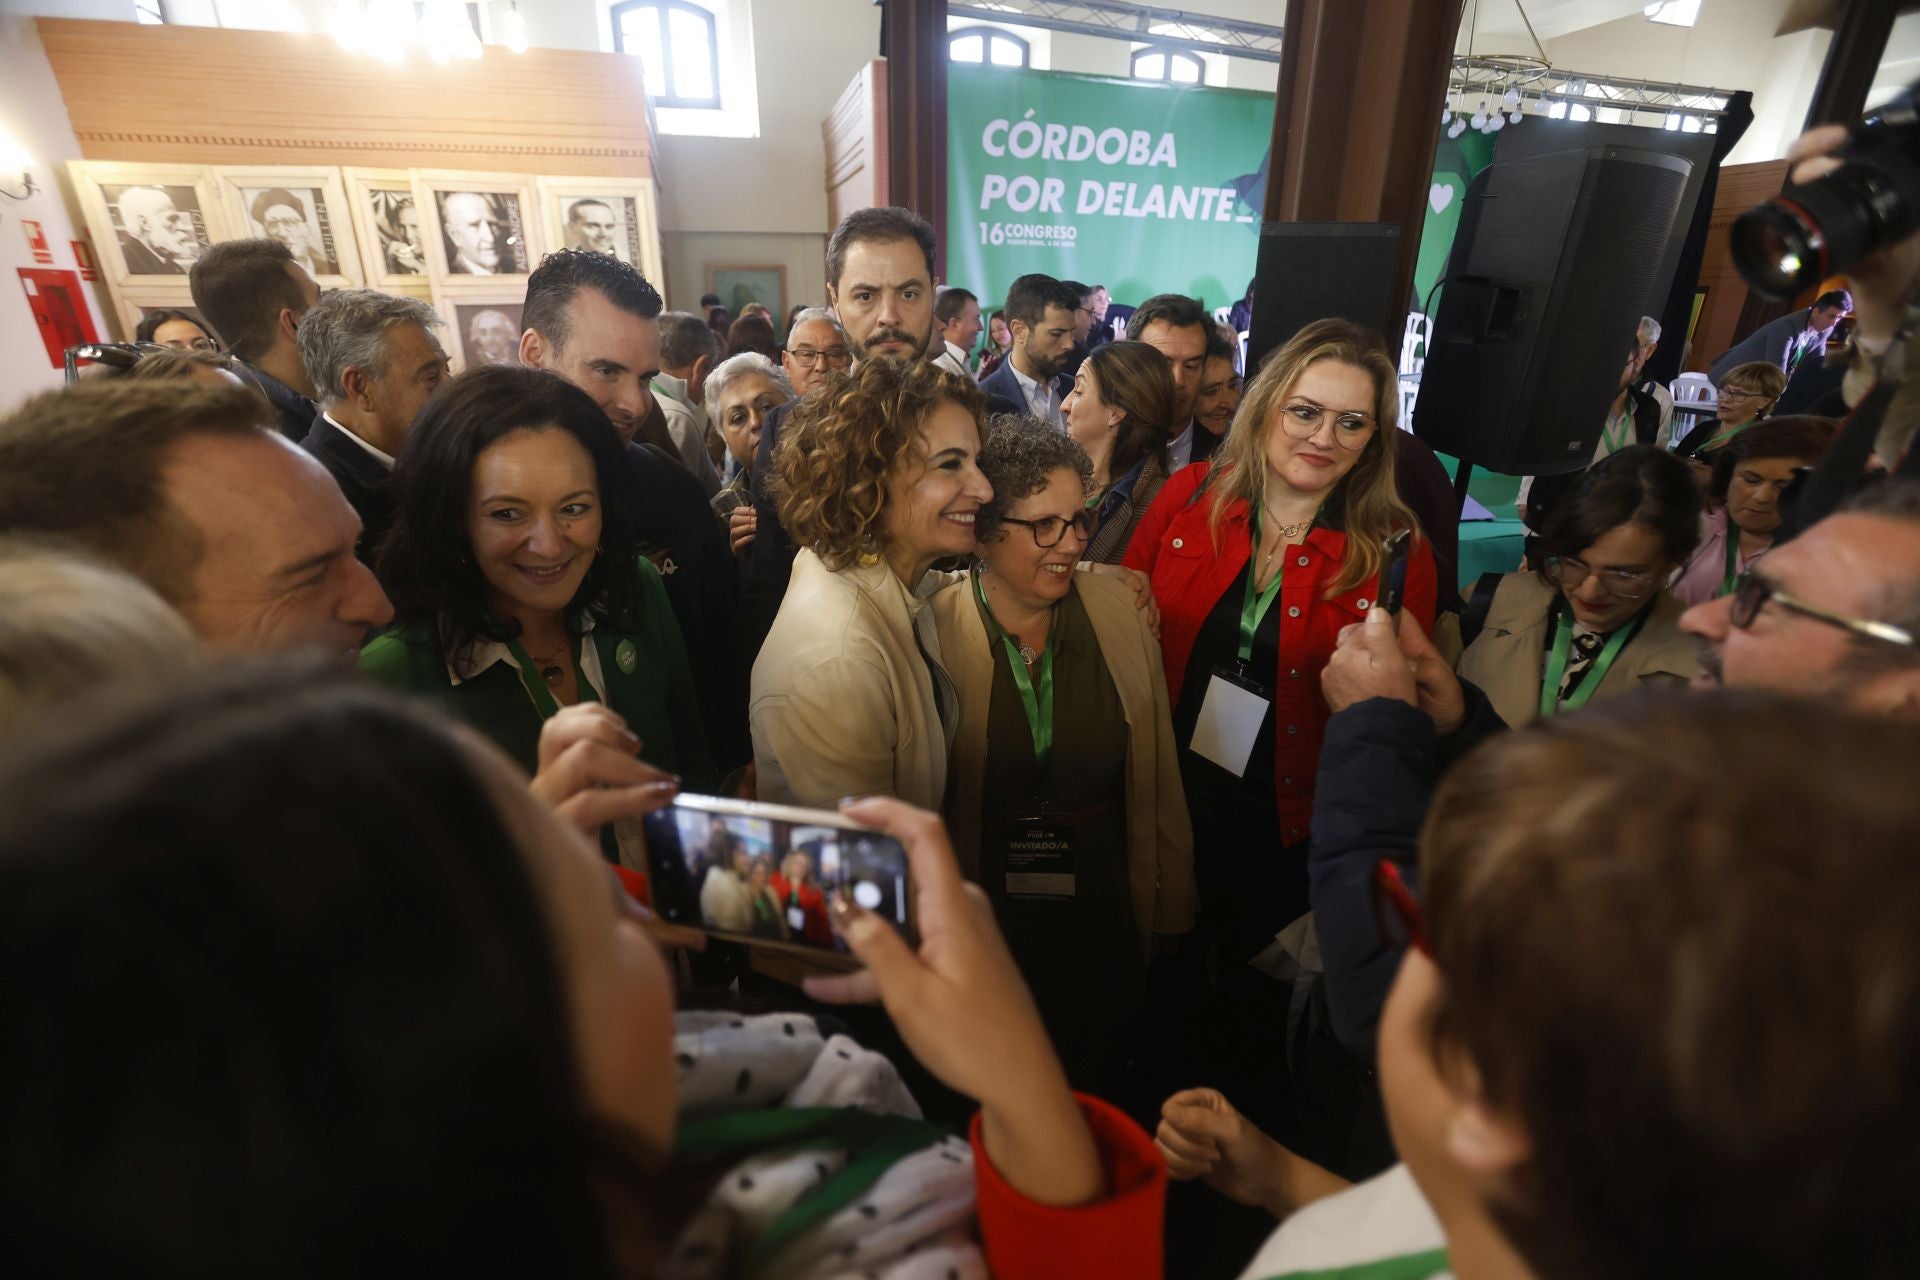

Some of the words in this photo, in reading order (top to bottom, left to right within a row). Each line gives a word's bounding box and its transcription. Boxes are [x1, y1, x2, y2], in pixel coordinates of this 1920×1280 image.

[981, 108, 1177, 168] CÓRDOBA
[979, 174, 1065, 214] POR
[979, 222, 1005, 245] 16
[1005, 223, 1077, 240] CONGRESO
[1010, 841, 1069, 850] INVITADO/A
